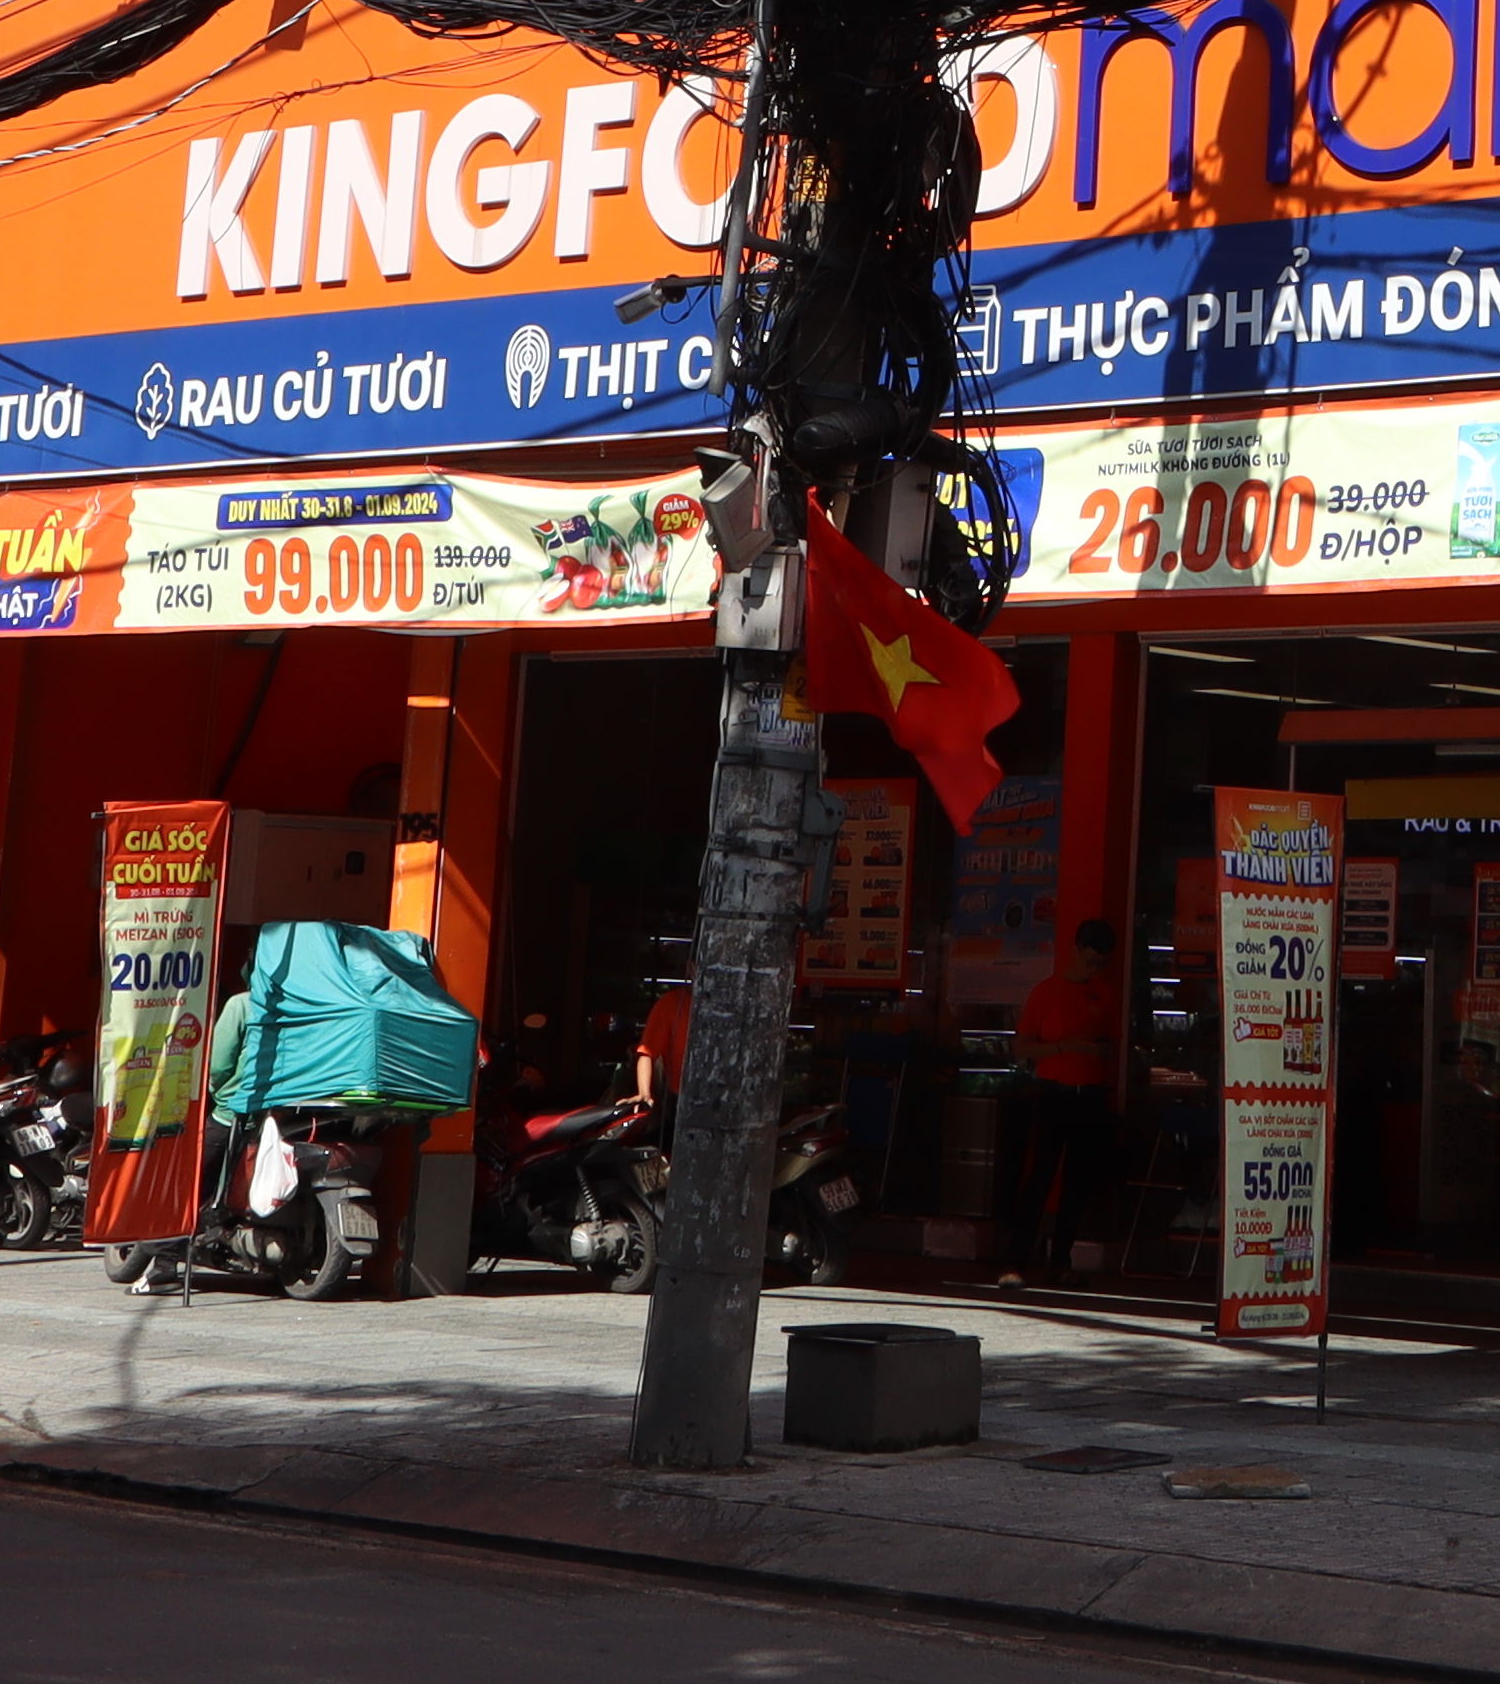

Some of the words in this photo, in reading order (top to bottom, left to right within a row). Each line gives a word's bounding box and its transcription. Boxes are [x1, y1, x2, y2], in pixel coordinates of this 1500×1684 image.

[1012, 291, 1170, 377] THỰC
[1185, 245, 1366, 352] PHẨM
[179, 373, 264, 428] RAU
[273, 349, 334, 421] CỦ
[342, 350, 449, 414] TƯƠI
[558, 337, 669, 410] THỊT
[1127, 436, 1154, 457] SỮA
[1157, 435, 1190, 455] TƯƠI
[1193, 434, 1226, 452] TƯƠI
[1228, 432, 1263, 454] SẠCH
[1098, 459, 1159, 478] NUTIMILK
[1161, 452, 1209, 475] KHÔNG
[1211, 448, 1265, 472] ĐƯỜNG
[1266, 448, 1292, 469] (1L)
[228, 497, 260, 524] DUY
[261, 490, 299, 522] NHẤT
[301, 493, 353, 519] 30-31.8
[365, 490, 439, 516] 01.09.2024
[1326, 478, 1430, 514] 39.000
[659, 510, 700, 533] 29%
[1068, 475, 1316, 575] 26.000
[146, 545, 189, 573] TÁO
[194, 542, 230, 572] TÚI
[1319, 518, 1425, 564] Đ/HỘP
[156, 582, 213, 614] (2KG)
[243, 532, 424, 616] 99.000
[432, 579, 485, 608] Đ/TÚI
[125, 824, 163, 853] GIÁ
[168, 821, 208, 853] SỐC
[1250, 825, 1279, 852] ĐẶC
[1280, 818, 1329, 853] QUYỀN
[113, 854, 161, 885] CUỐI
[166, 853, 217, 885] TUẦN
[1220, 848, 1287, 887] THÀNH
[1293, 852, 1335, 887] VIÊN
[134, 909, 150, 924] MÌ
[115, 927, 168, 942] MEIZAN
[111, 951, 204, 992] 20.000
[1236, 959, 1266, 977] GIẢM
[1268, 935, 1325, 982] 20%
